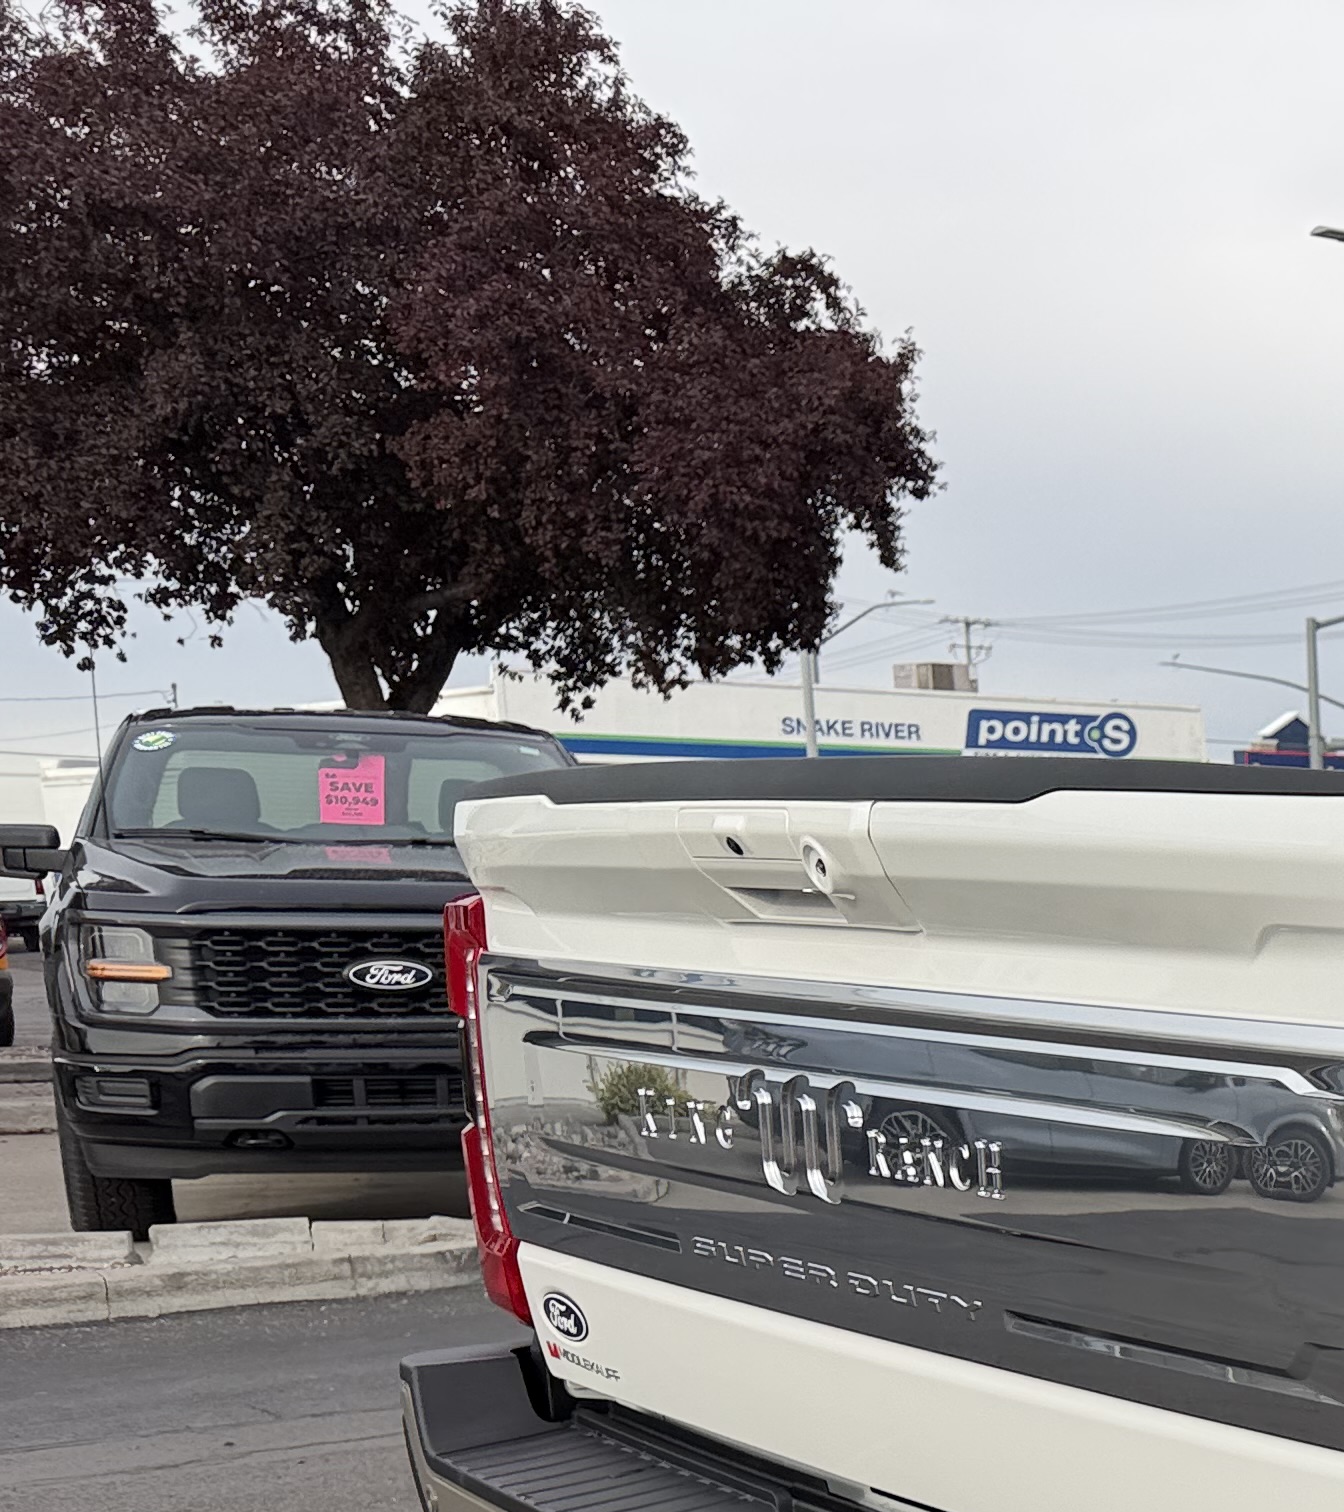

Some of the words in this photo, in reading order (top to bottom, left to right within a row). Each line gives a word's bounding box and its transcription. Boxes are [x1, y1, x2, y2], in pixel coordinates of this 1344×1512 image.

[781, 716, 854, 737] SNAKE
[860, 721, 921, 741] RIVER
[977, 714, 1082, 747] point
[1101, 717, 1132, 752] S
[325, 794, 379, 807] $10,949
[329, 781, 374, 793] SAVE
[365, 964, 417, 985] Ford
[637, 1086, 735, 1150] KING
[865, 1127, 1006, 1202] RANCH
[691, 1236, 838, 1288] SUPER
[847, 1271, 983, 1321] DUTY
[549, 1299, 578, 1335] Ford
